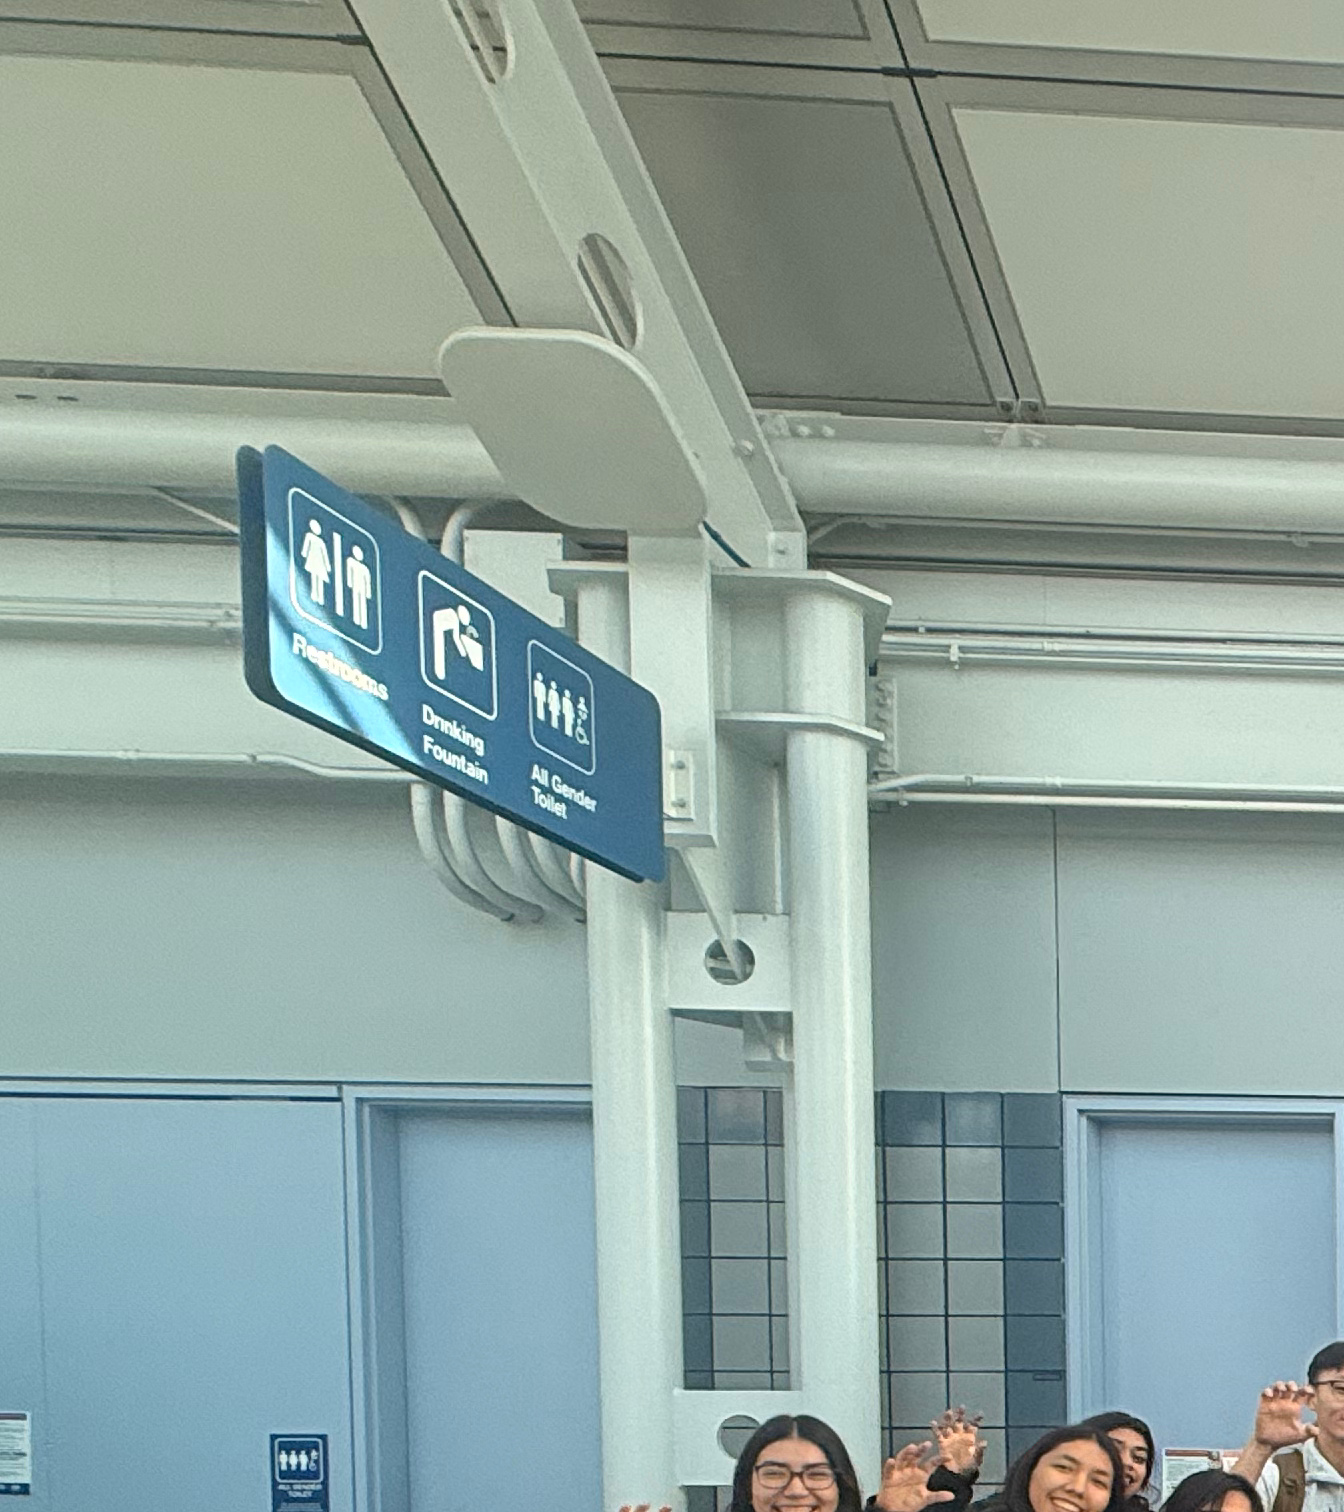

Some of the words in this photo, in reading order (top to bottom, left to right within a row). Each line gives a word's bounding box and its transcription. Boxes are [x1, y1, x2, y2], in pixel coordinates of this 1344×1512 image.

[292, 632, 389, 701] Restrooms
[422, 703, 485, 757] Drinking
[423, 734, 488, 785] Fountain
[531, 763, 549, 787] All
[551, 774, 597, 812] Gender
[531, 785, 567, 820] Toilet
